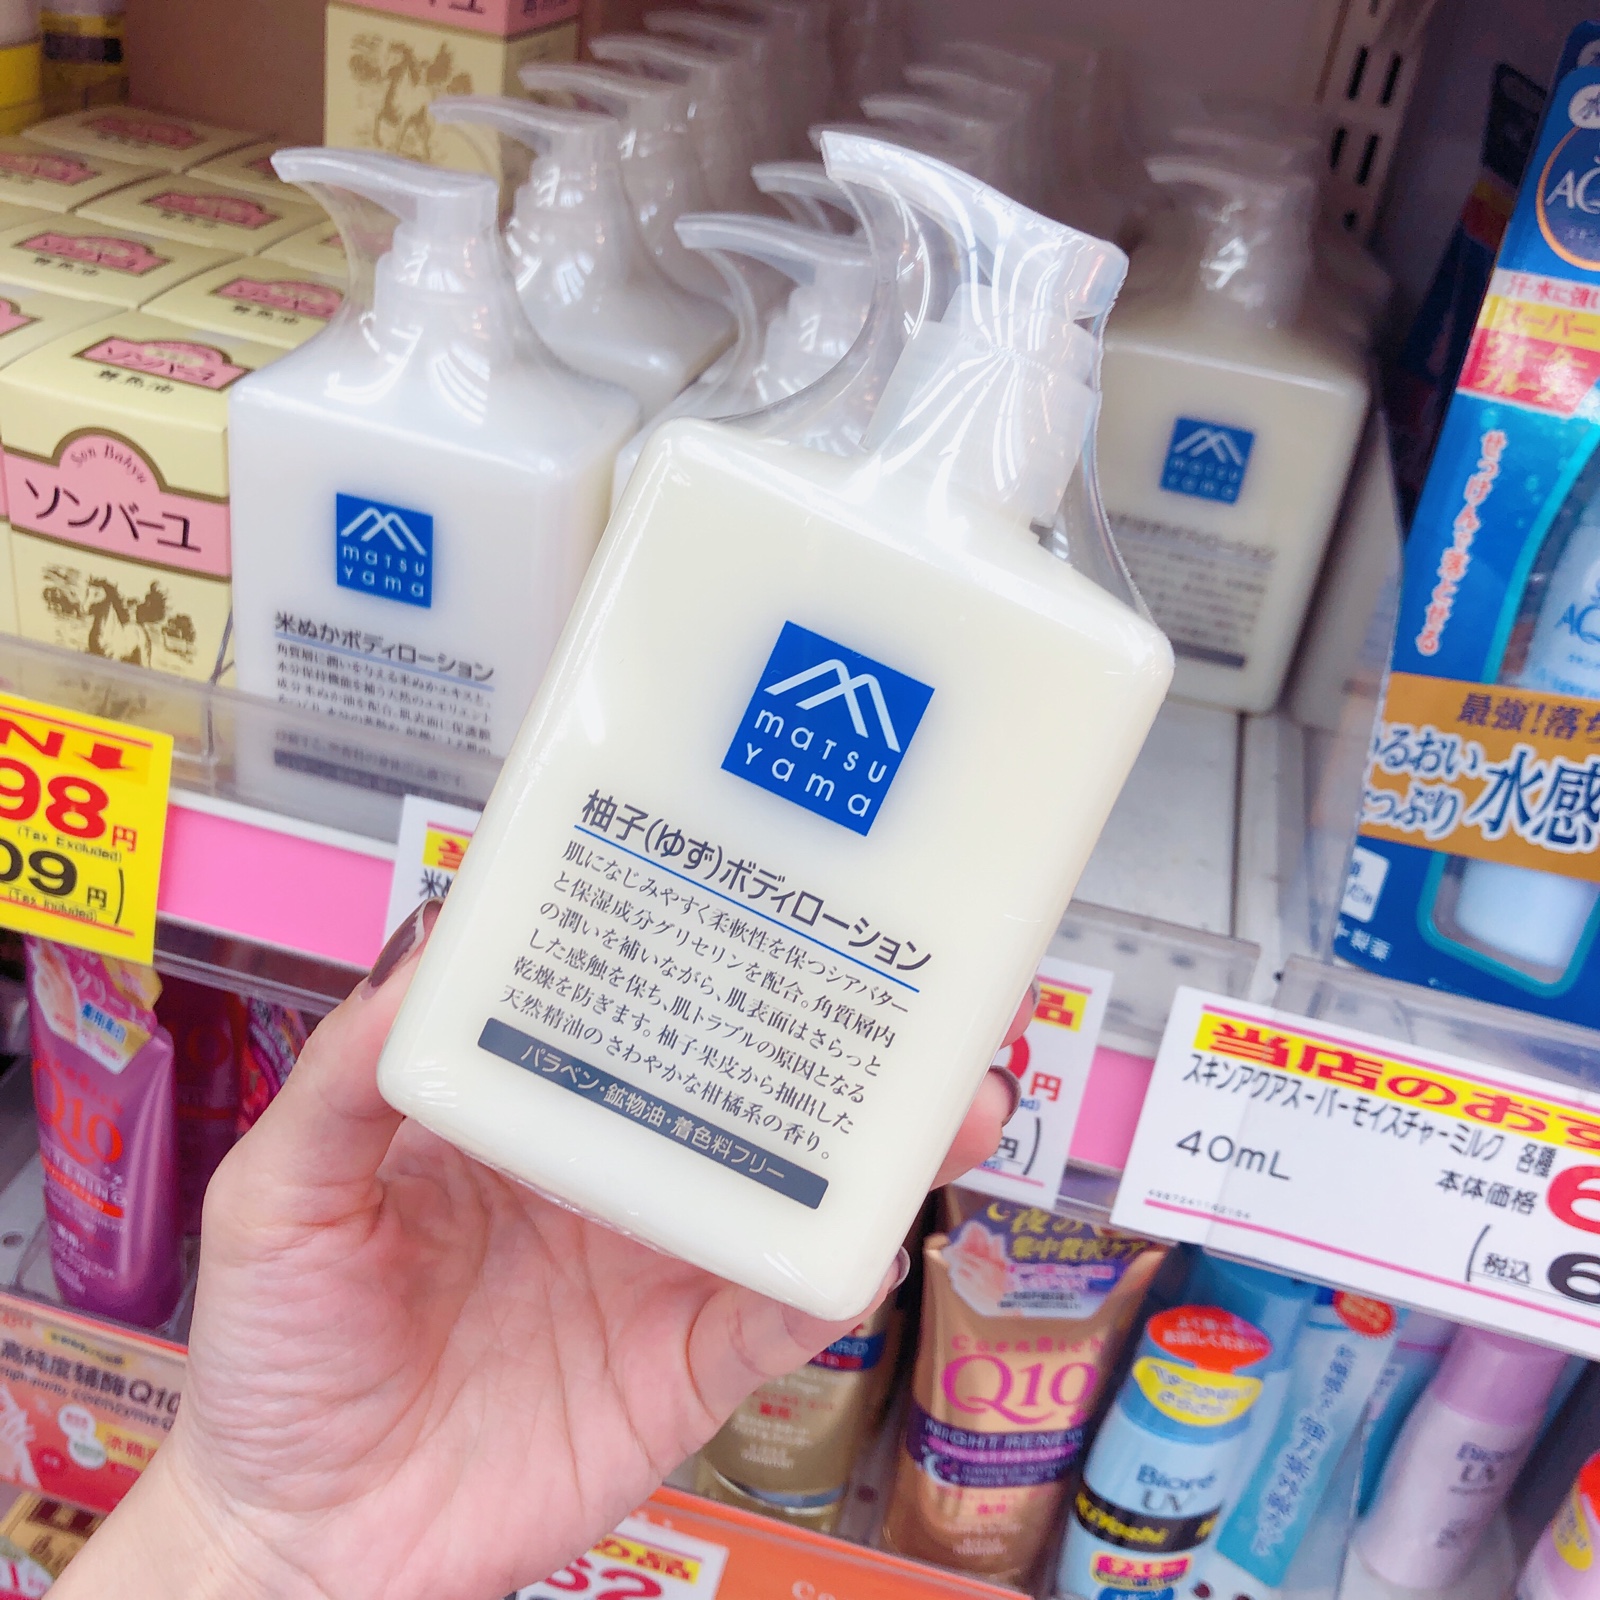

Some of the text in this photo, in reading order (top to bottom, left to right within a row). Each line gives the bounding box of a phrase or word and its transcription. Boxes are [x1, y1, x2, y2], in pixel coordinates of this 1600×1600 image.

[25, 478, 202, 553] ソンバーユ
[342, 543, 425, 577] matsu
[275, 610, 494, 682] 米ぬかボディローション
[754, 709, 887, 783] matsu
[1374, 729, 1479, 776] るおい
[1364, 786, 1460, 838] っぷり
[1466, 750, 1600, 846] 水感
[561, 839, 910, 1014] 肌になじみやすく柔軟性を保つシアバター
[580, 789, 932, 973] 柚子(ゆず)ボディローション
[539, 901, 882, 1078] の潤いを補いながら、肌表面はさらっと
[553, 871, 896, 1049] と保湿成分グリセリンを配合。角質層内
[512, 955, 854, 1135] 乾燥を防ぎます。柚子果皮から抽出した
[528, 928, 865, 1104] した感触を保ち、肌トラブルの原因となる
[501, 984, 830, 1160] 天然精油のさわやかな柑橘系の香り。
[521, 1043, 785, 1180] パラベン・鉱物油・着色料フリー
[1182, 1053, 1504, 1163] スキンアクアスーパーモイスチャーミルク
[1175, 1129, 1291, 1182] 40mL
[1436, 1169, 1539, 1216] 本体価格
[941, 1354, 1098, 1426] Q10
